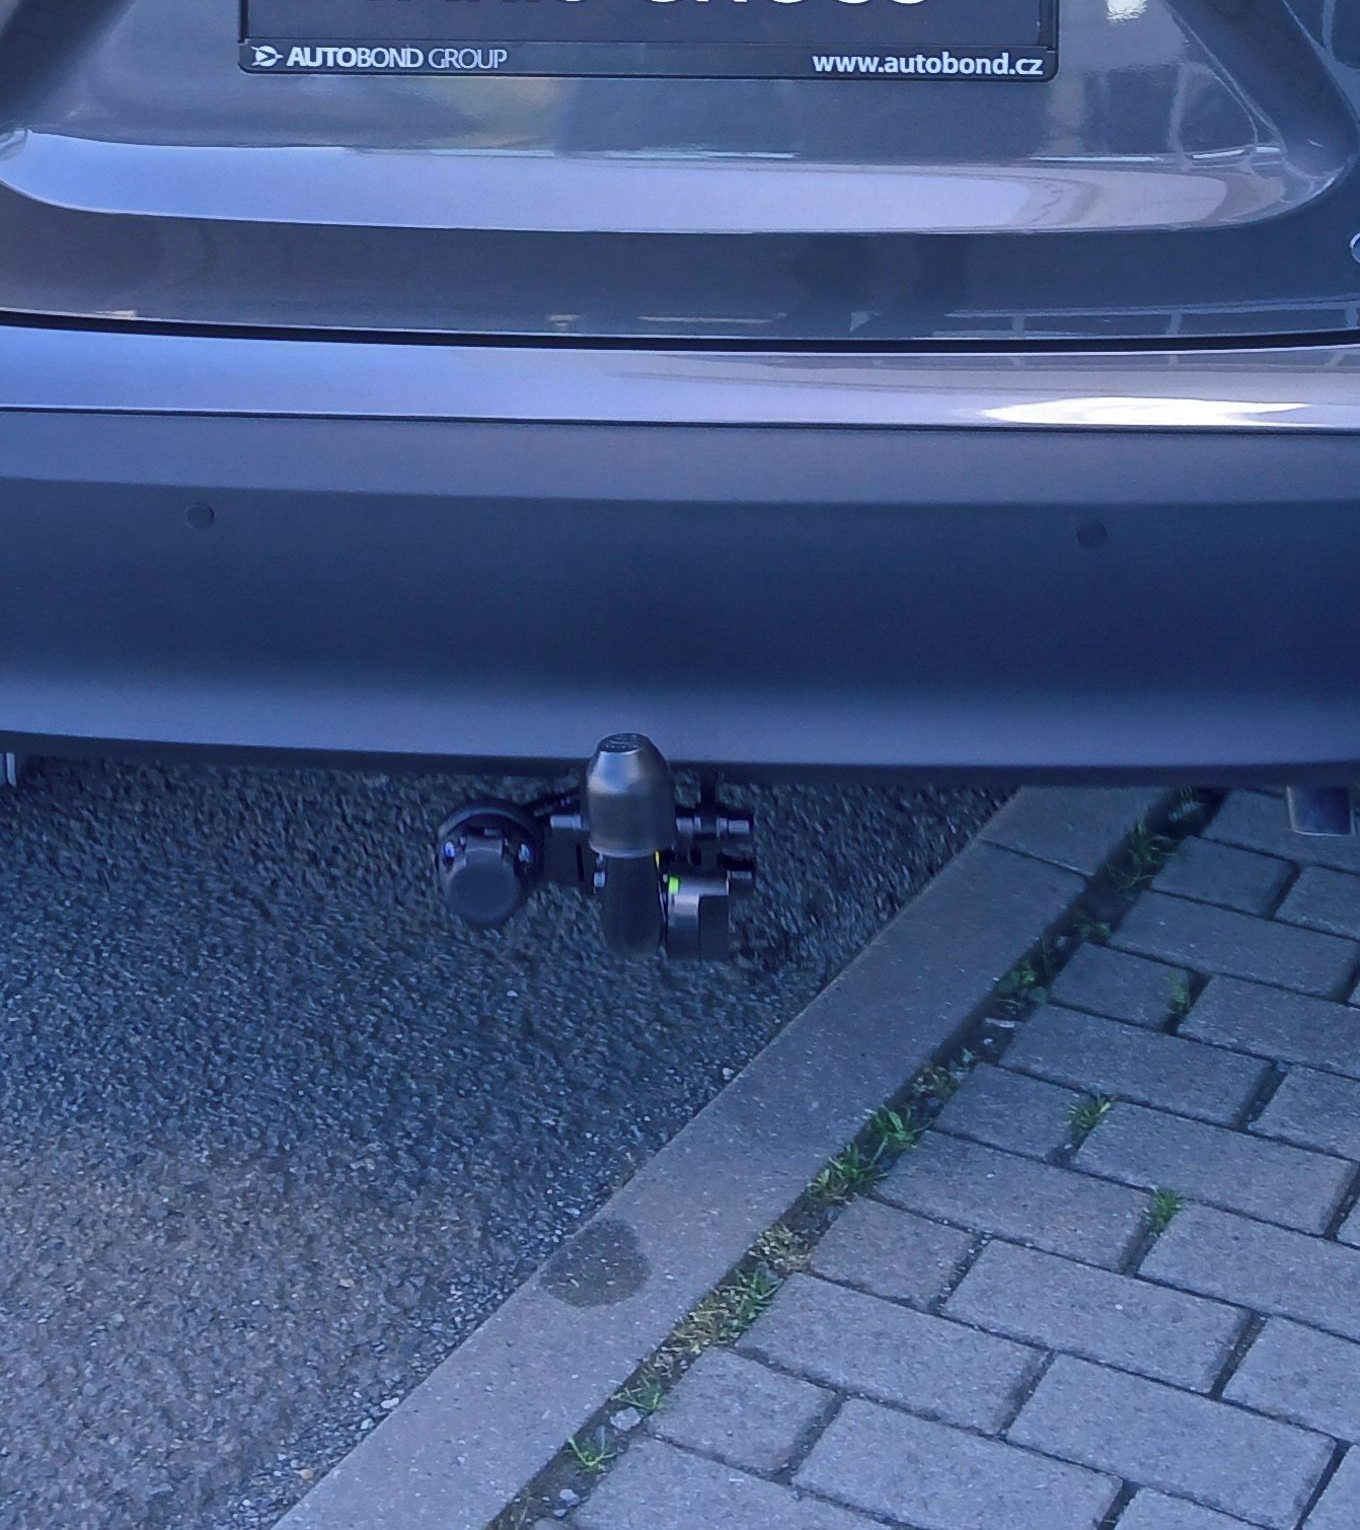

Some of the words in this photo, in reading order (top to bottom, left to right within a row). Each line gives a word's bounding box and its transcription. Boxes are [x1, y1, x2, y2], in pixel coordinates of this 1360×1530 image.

[286, 46, 424, 68] AUTOBOND
[428, 47, 508, 70] GROUP
[812, 52, 1044, 76] www.autobond.cz
